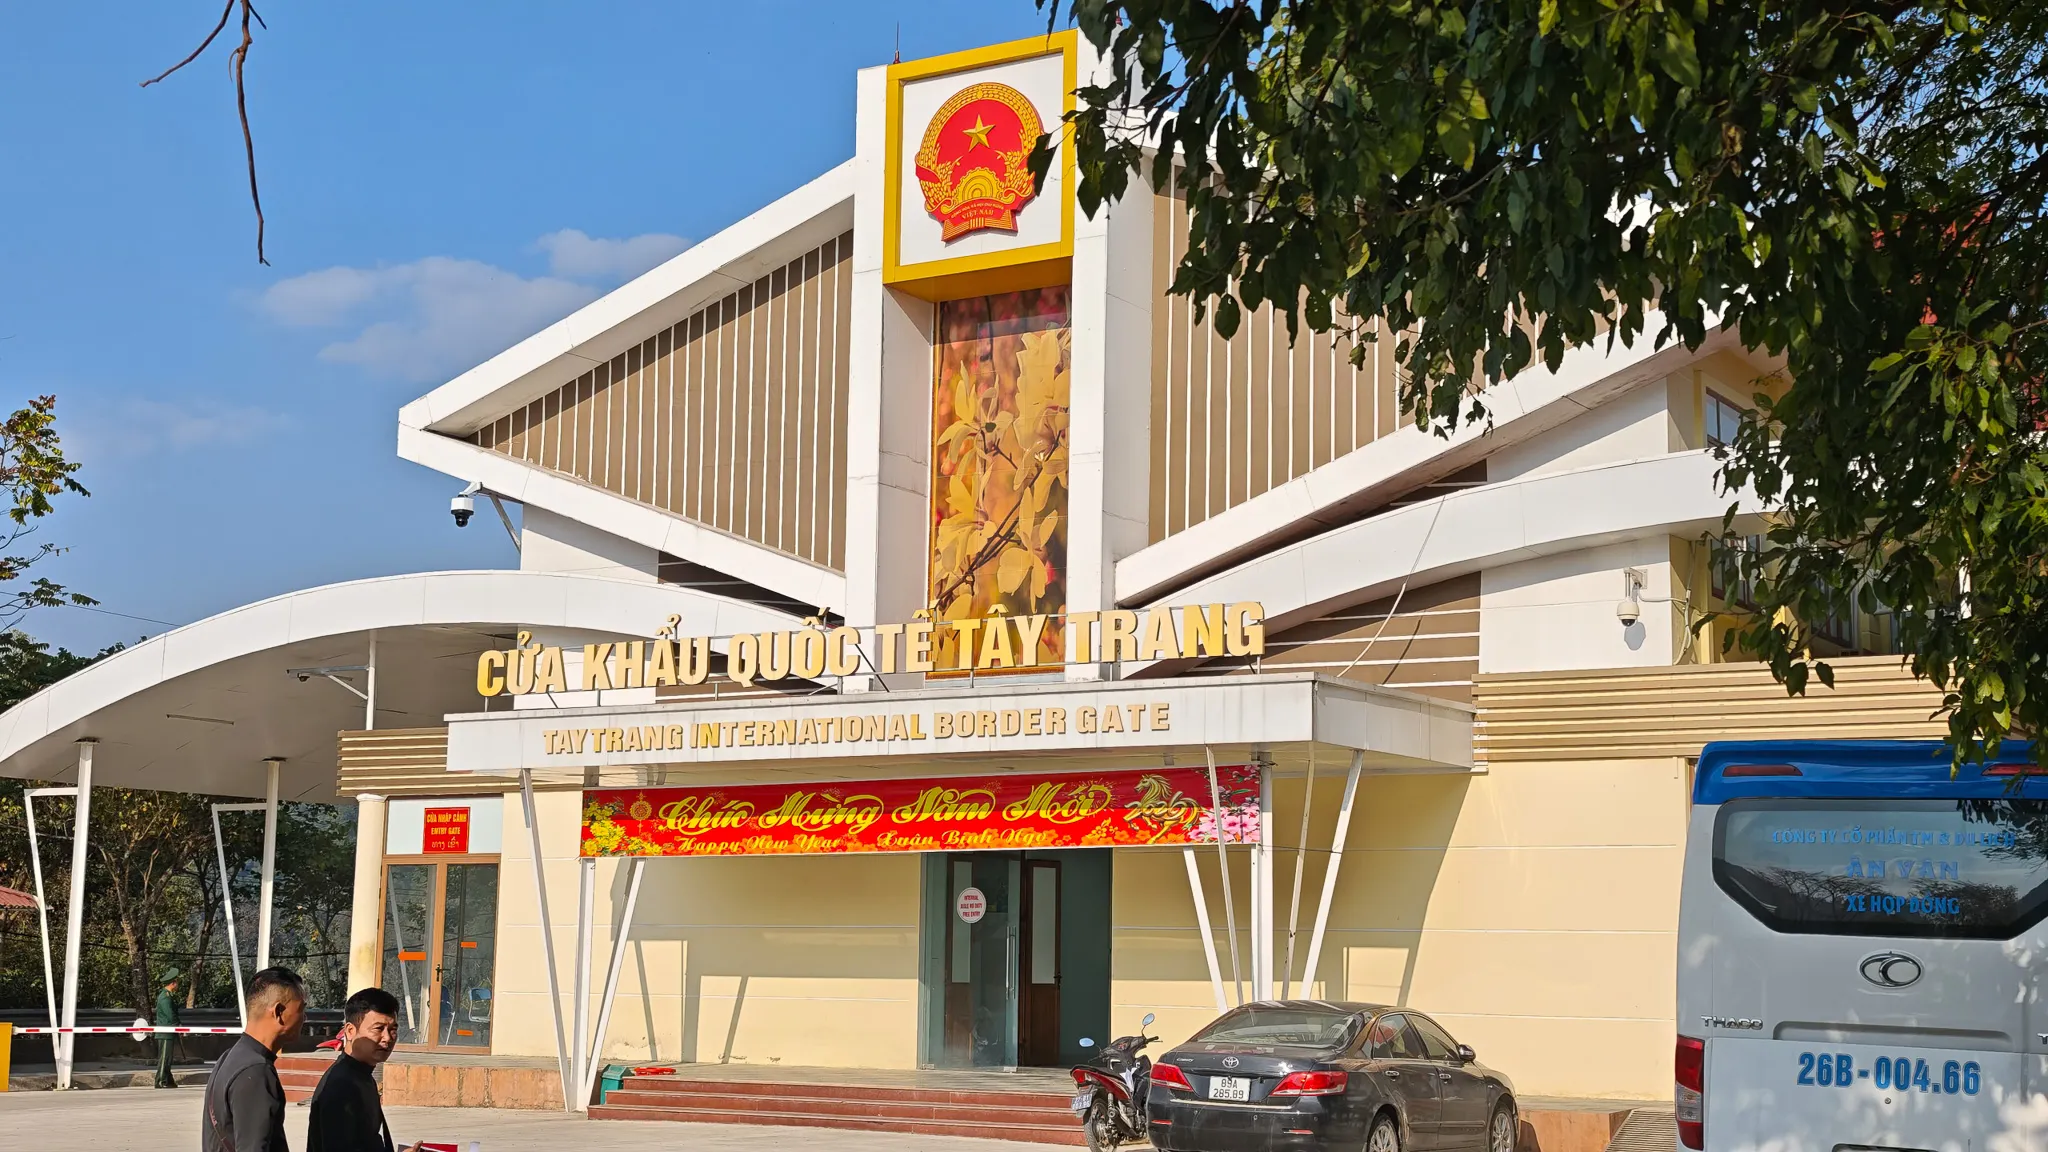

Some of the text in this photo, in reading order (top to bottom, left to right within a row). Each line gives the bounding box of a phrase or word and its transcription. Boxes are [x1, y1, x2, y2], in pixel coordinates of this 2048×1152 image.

[477, 598, 1266, 696] CỬA KHẨU QUỐC TẾ TÂY TRANG
[544, 702, 1170, 755] TAY TRANG INTERNATIONAL BORDER GATE
[658, 781, 1111, 836] Chúc Mừng Năm Mới
[677, 837, 740, 853] Happy
[747, 835, 789, 850] New
[796, 834, 841, 850] Year
[877, 831, 934, 848] Xuân
[1820, 829, 1837, 843] TY
[1954, 831, 1976, 846] DU
[1847, 895, 1867, 912] XE
[1700, 1015, 1763, 1031] THACO
